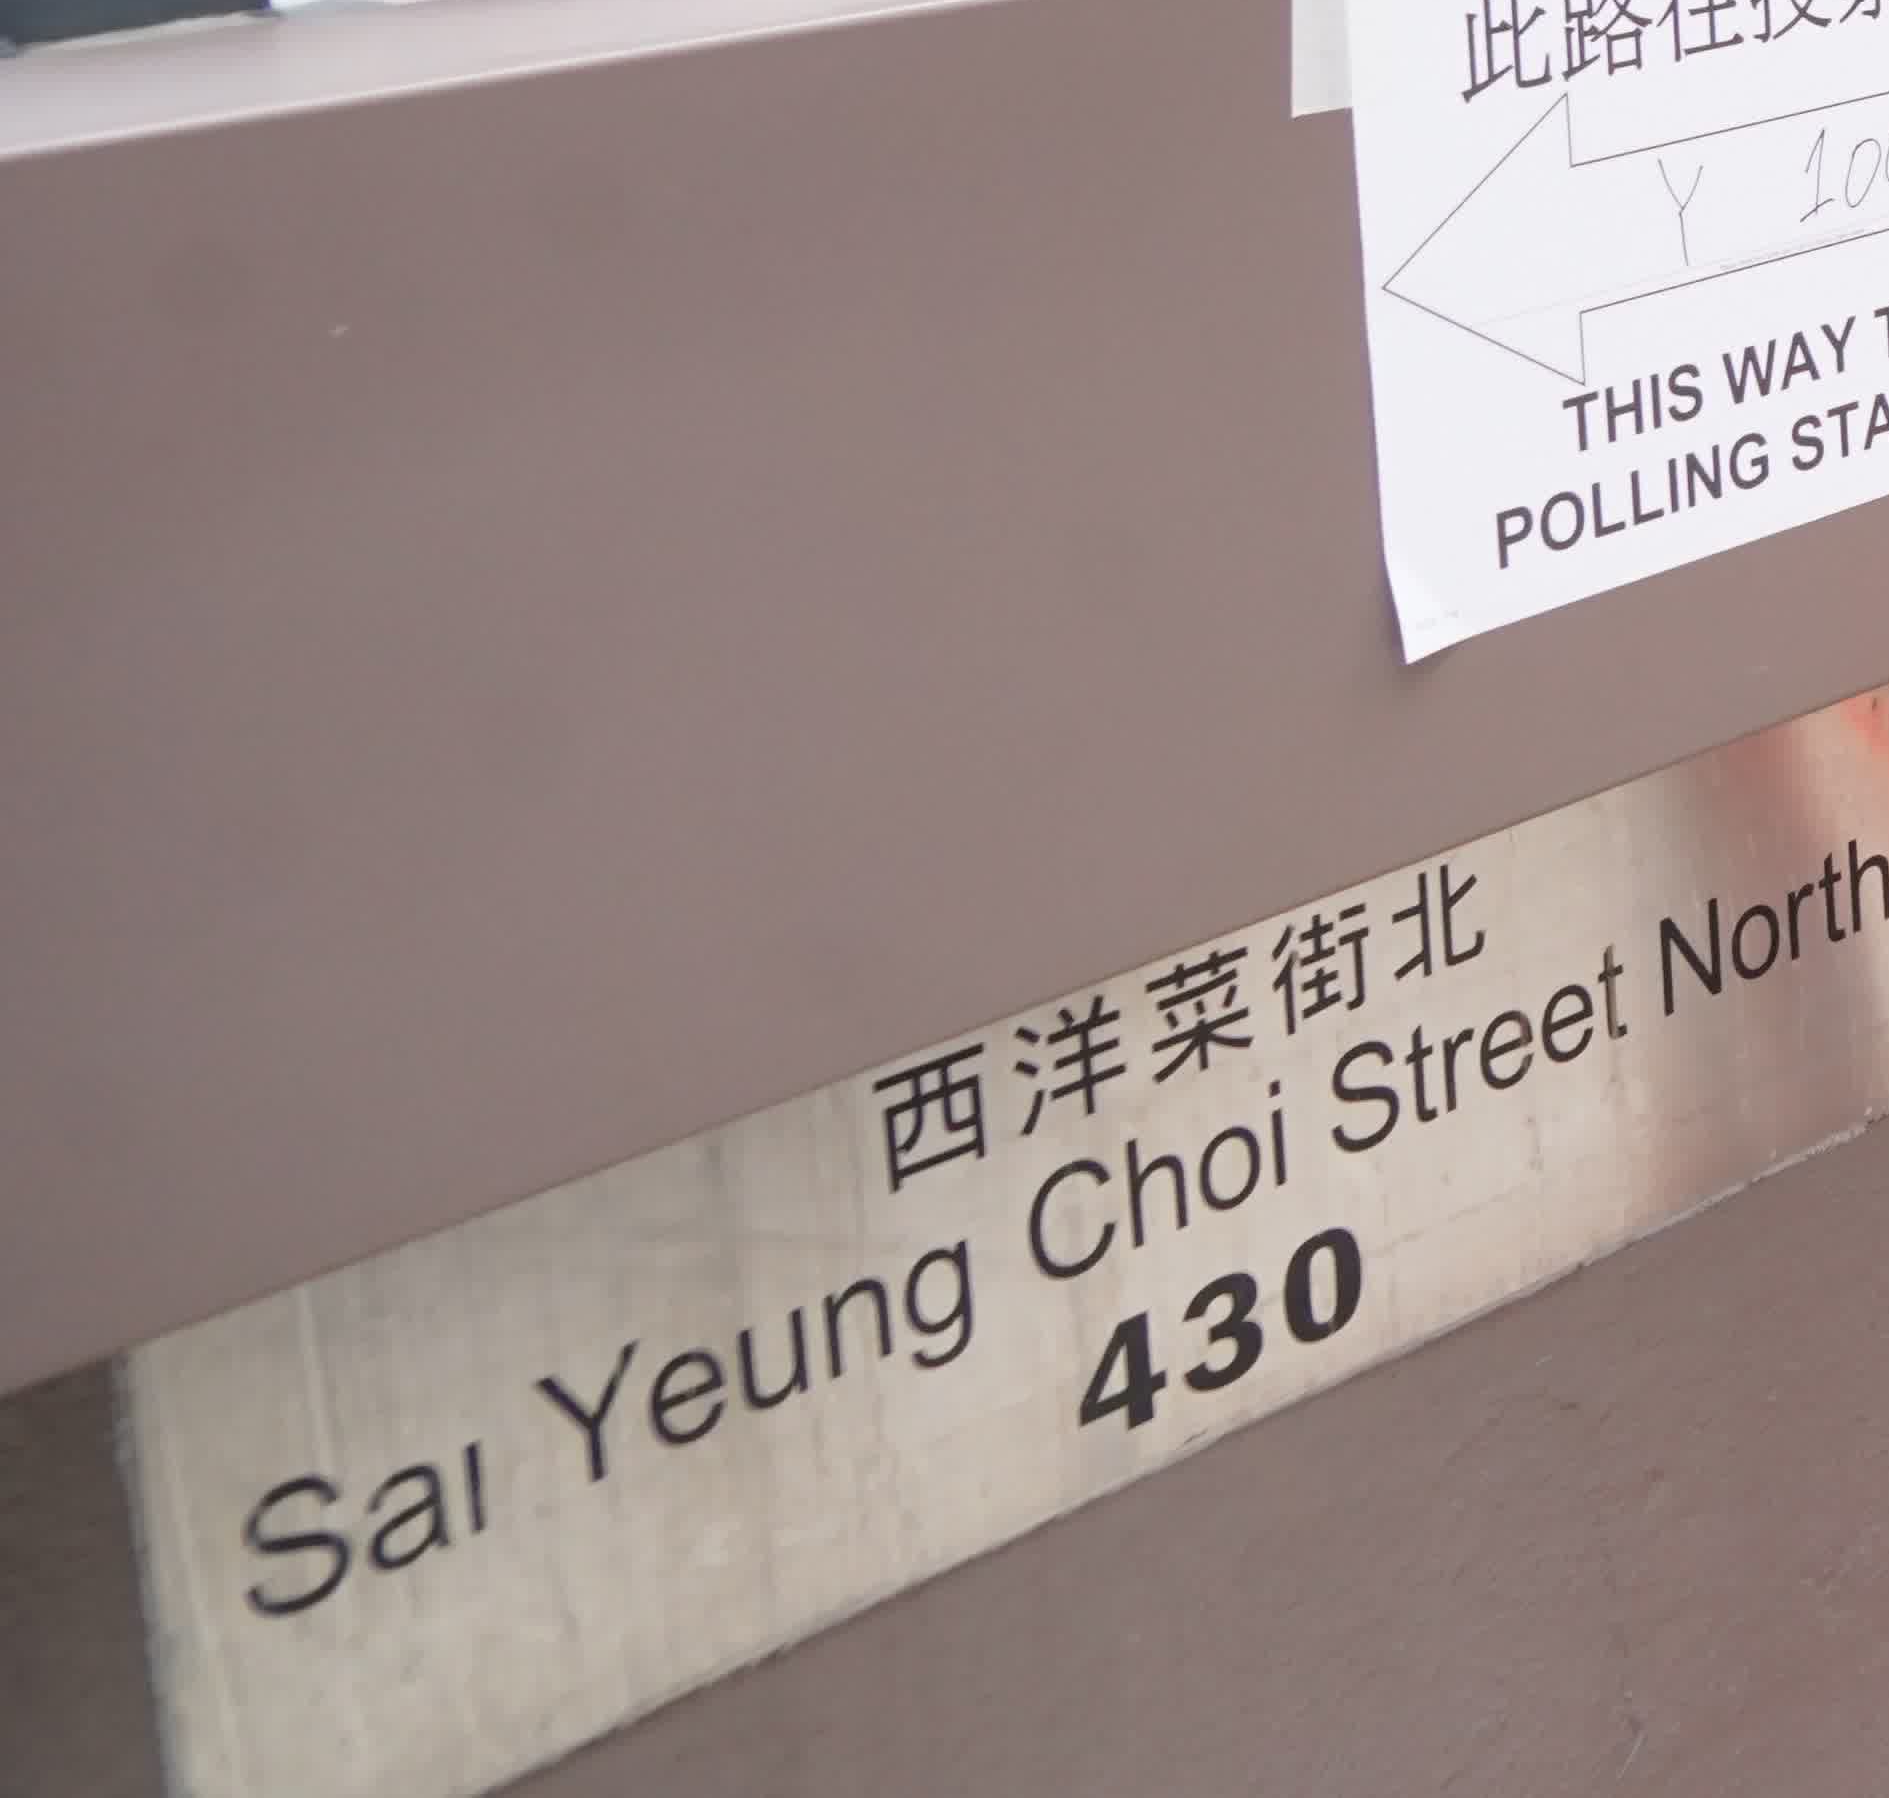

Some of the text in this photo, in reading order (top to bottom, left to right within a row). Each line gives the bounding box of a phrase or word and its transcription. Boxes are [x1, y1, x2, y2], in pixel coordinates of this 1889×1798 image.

[1658, 157, 1704, 267] Y
[1563, 365, 1703, 452] THIS
[1721, 317, 1857, 407] WAY
[1495, 431, 1769, 569] POLLING
[872, 863, 1488, 1192] 西洋菜街北
[244, 1443, 486, 1617] Sai
[533, 1238, 973, 1483] Yeung
[1028, 1082, 1287, 1281] Choi
[1329, 949, 1626, 1152] Street
[1077, 1226, 1365, 1433] 430
